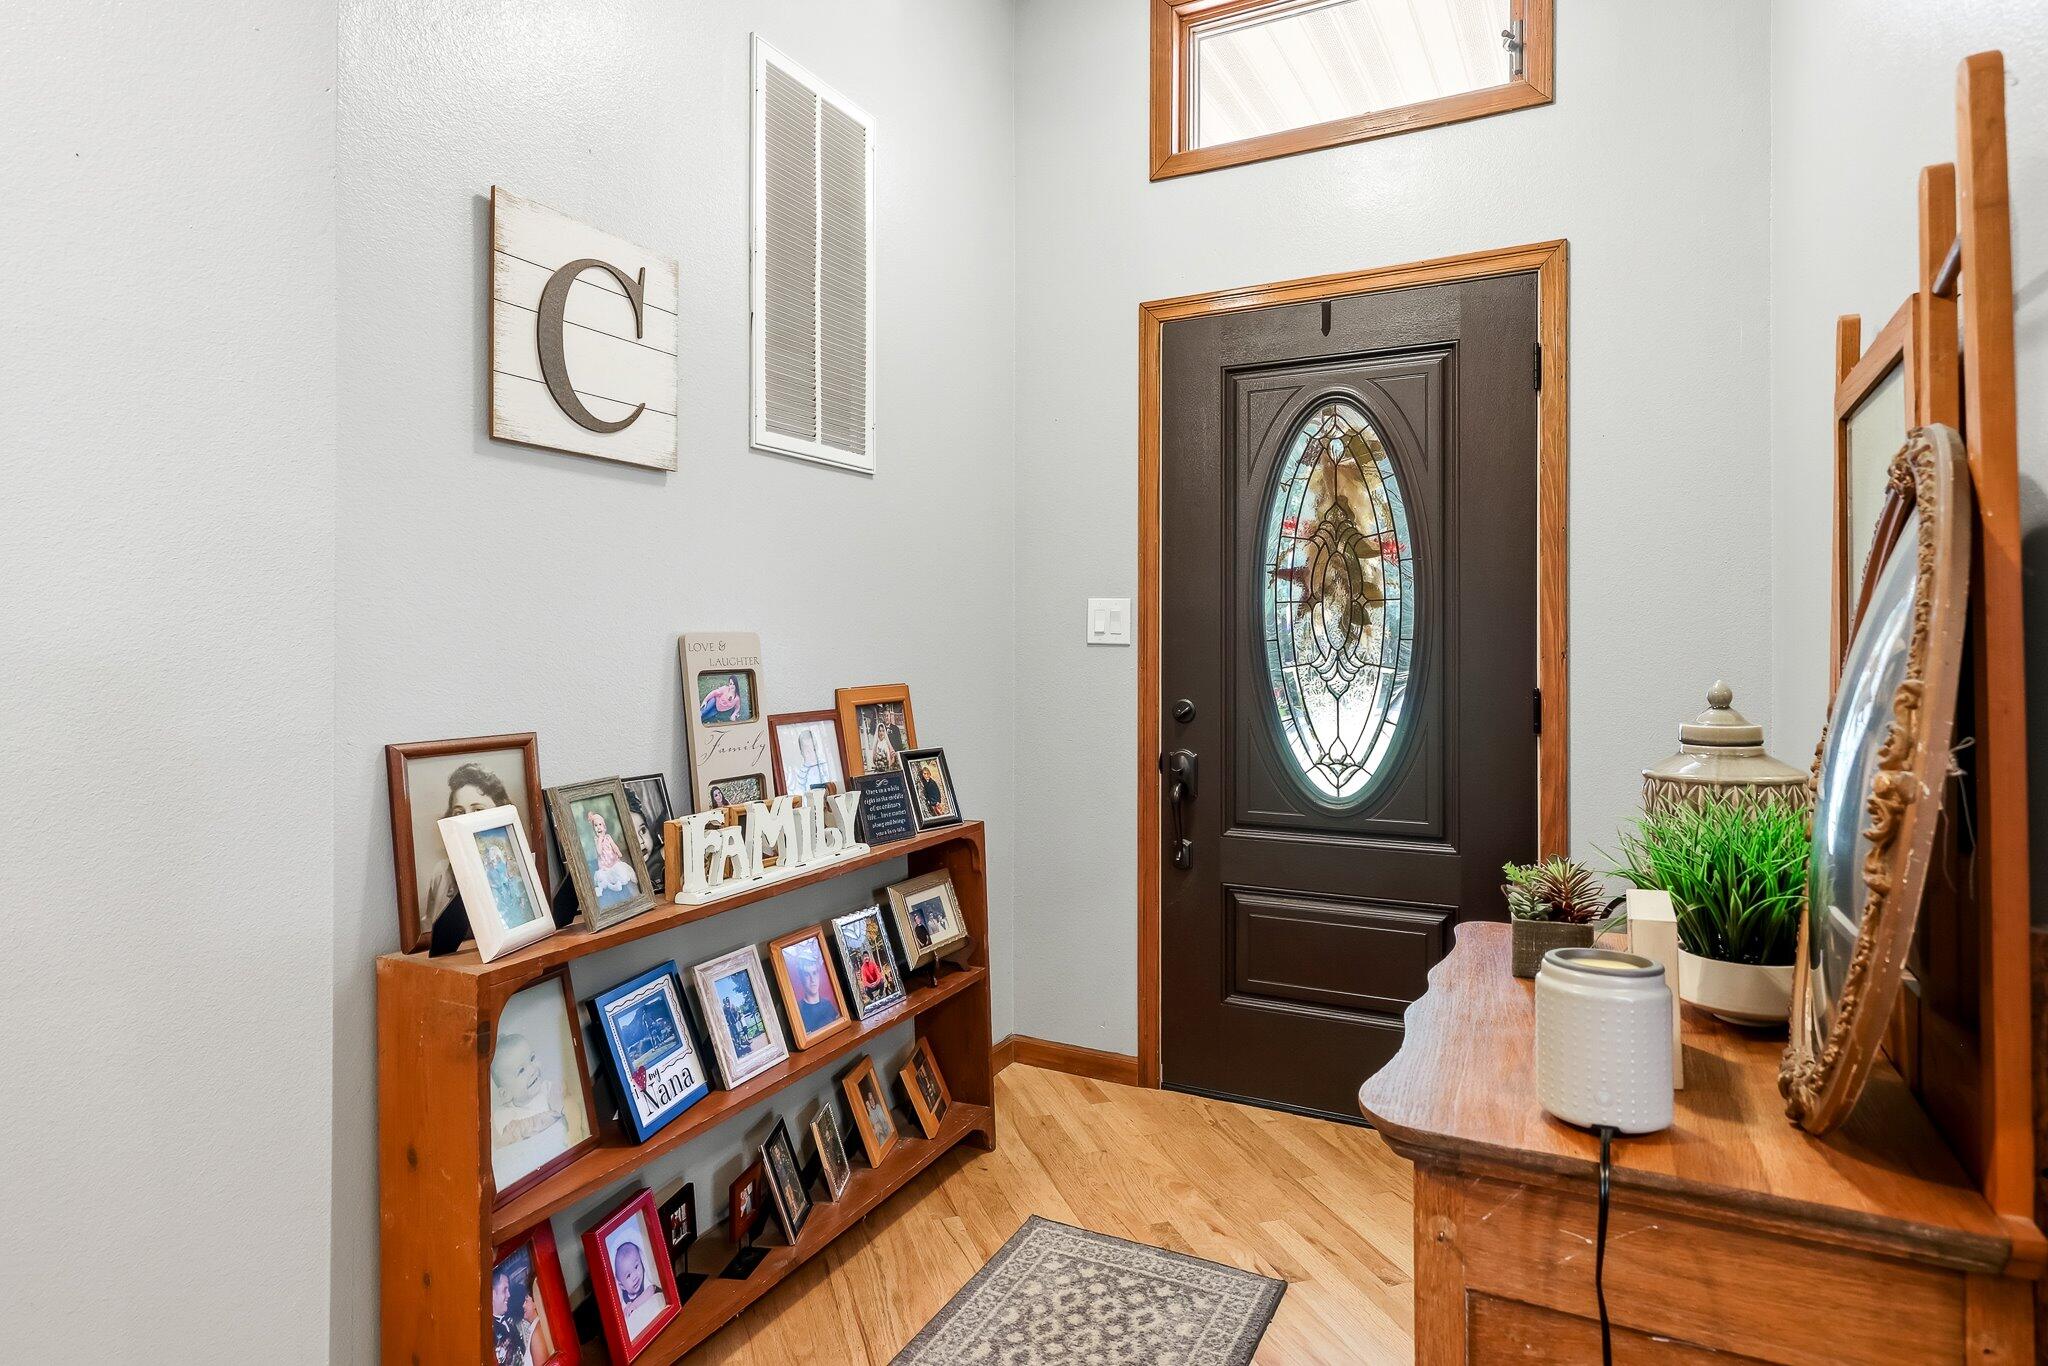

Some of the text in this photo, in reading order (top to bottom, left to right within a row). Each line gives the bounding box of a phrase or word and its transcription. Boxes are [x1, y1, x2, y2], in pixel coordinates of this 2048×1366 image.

[536, 258, 646, 434] C
[688, 640, 727, 652] LOVE &
[709, 656, 760, 667] LAUGHTER
[697, 729, 767, 767] Family
[680, 788, 861, 893] FAMILY
[643, 1067, 695, 1117] Nana
[648, 1068, 661, 1083] my
